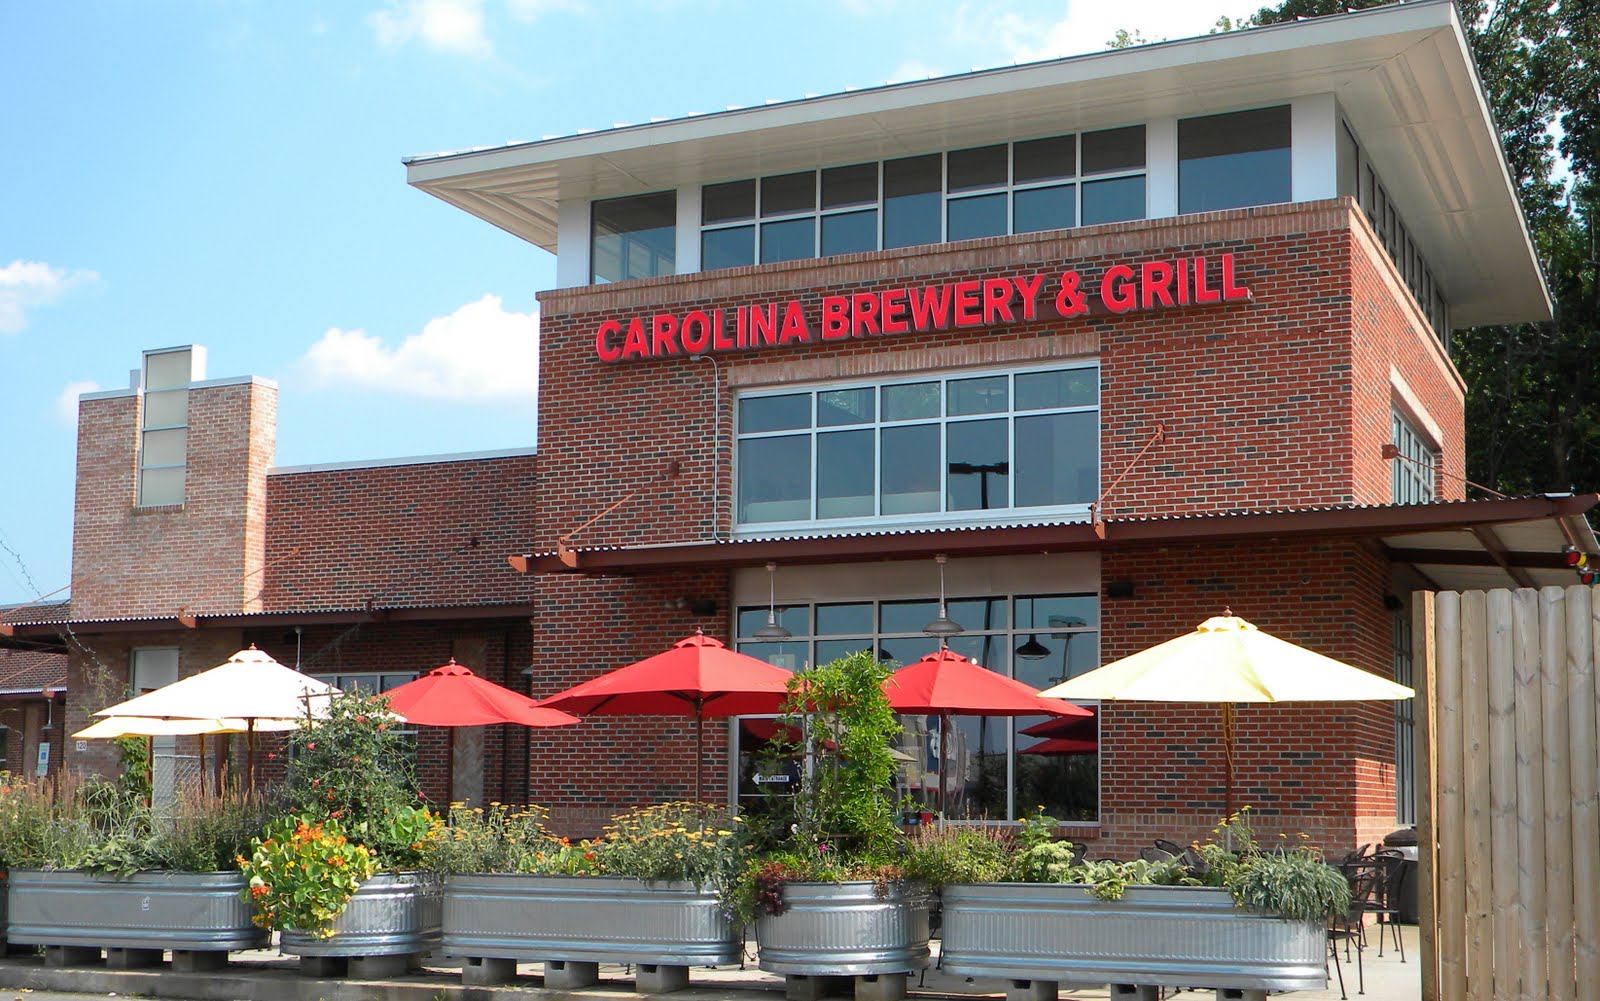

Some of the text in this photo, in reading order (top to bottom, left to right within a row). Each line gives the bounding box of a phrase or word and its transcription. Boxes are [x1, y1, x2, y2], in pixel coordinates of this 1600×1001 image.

[595, 254, 1248, 362] CAROLINA BREWERY & GRILL
[76, 741, 86, 750] 120
